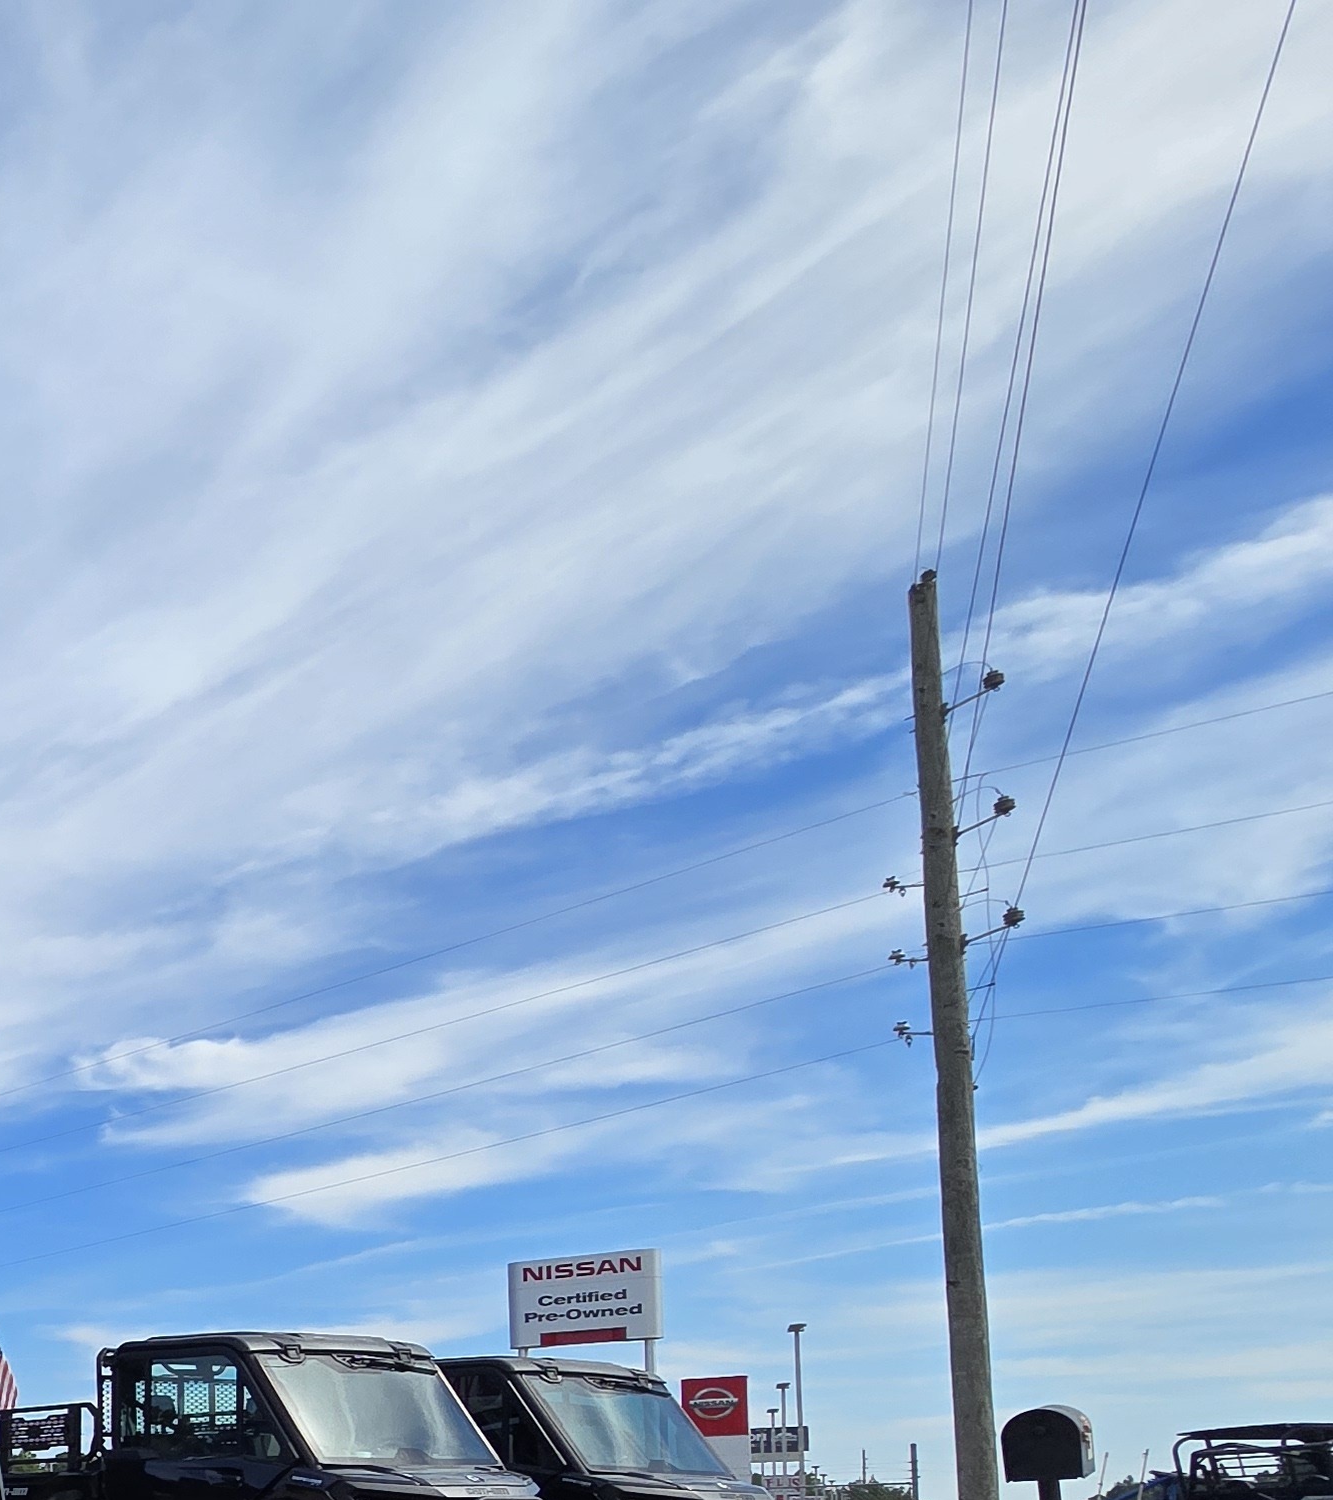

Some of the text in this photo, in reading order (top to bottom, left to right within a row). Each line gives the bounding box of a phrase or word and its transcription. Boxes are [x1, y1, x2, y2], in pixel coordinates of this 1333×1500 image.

[522, 1256, 642, 1282] NISSAN
[537, 1289, 627, 1306] Certified
[524, 1303, 643, 1323] Pre-Owned
